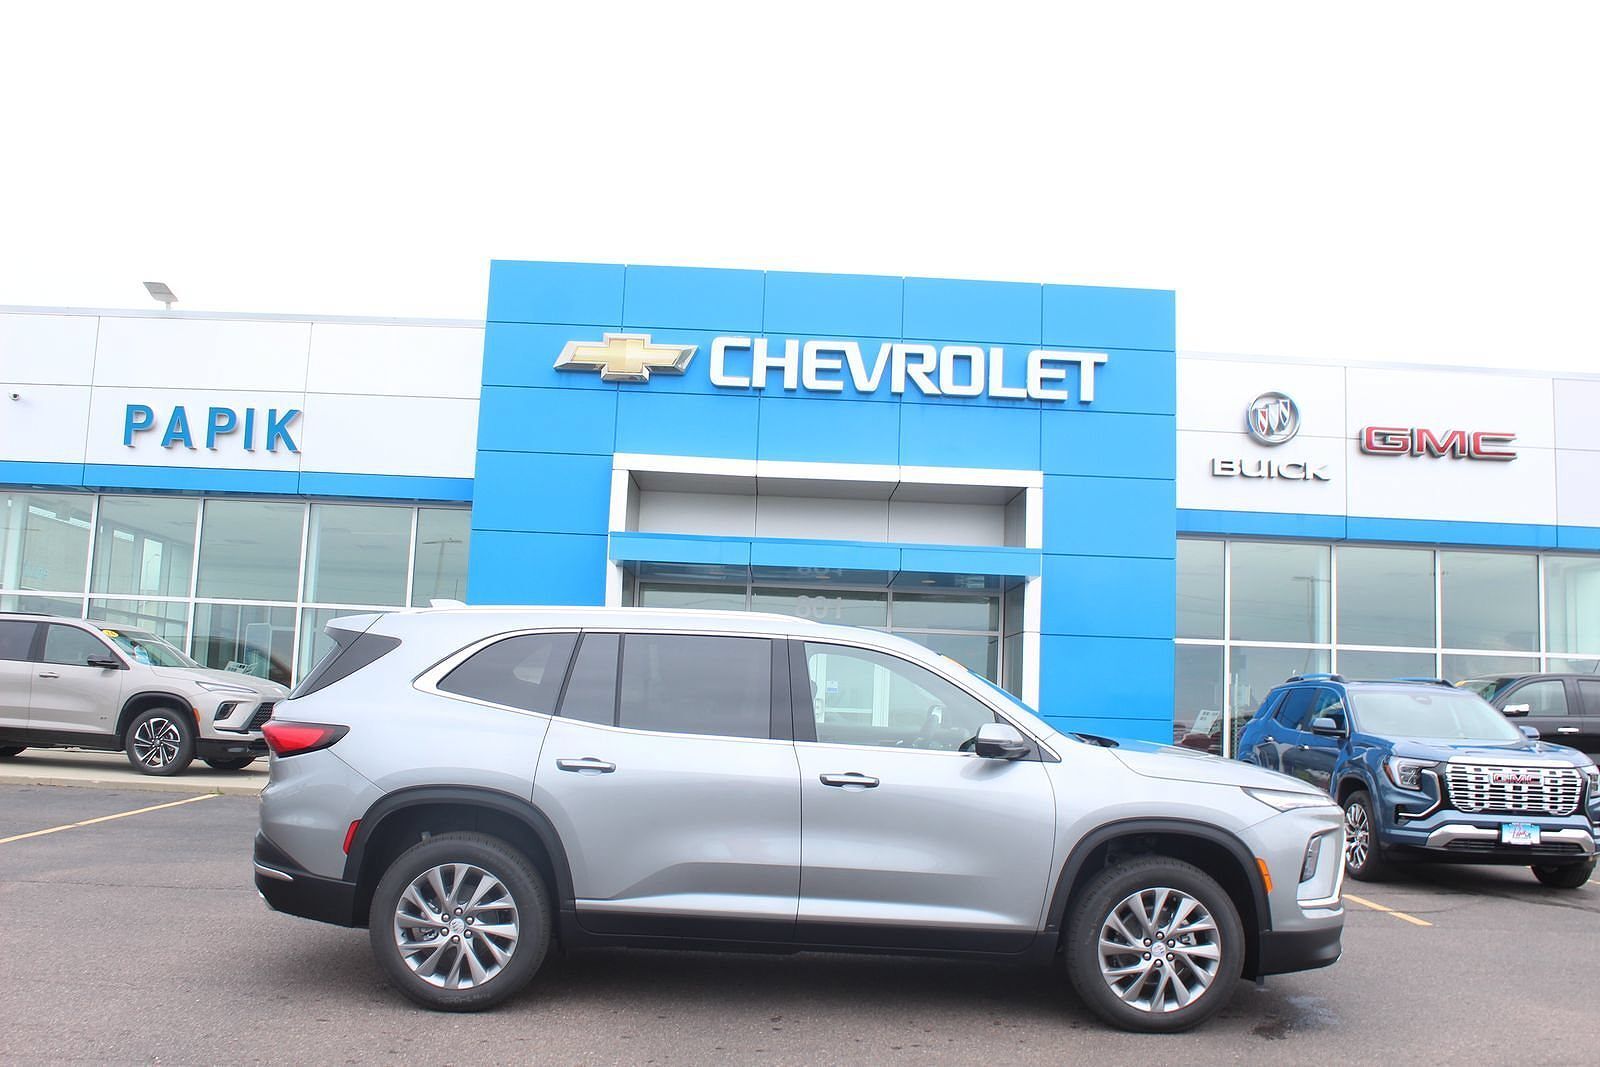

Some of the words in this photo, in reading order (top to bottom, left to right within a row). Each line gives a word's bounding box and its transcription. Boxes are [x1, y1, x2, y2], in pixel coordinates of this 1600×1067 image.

[709, 336, 1108, 402] CHEVROLET
[124, 404, 302, 454] PAPIK
[1359, 426, 1518, 461] GMC
[1212, 457, 1331, 481] BUICK
[1492, 772, 1541, 786] GMC
